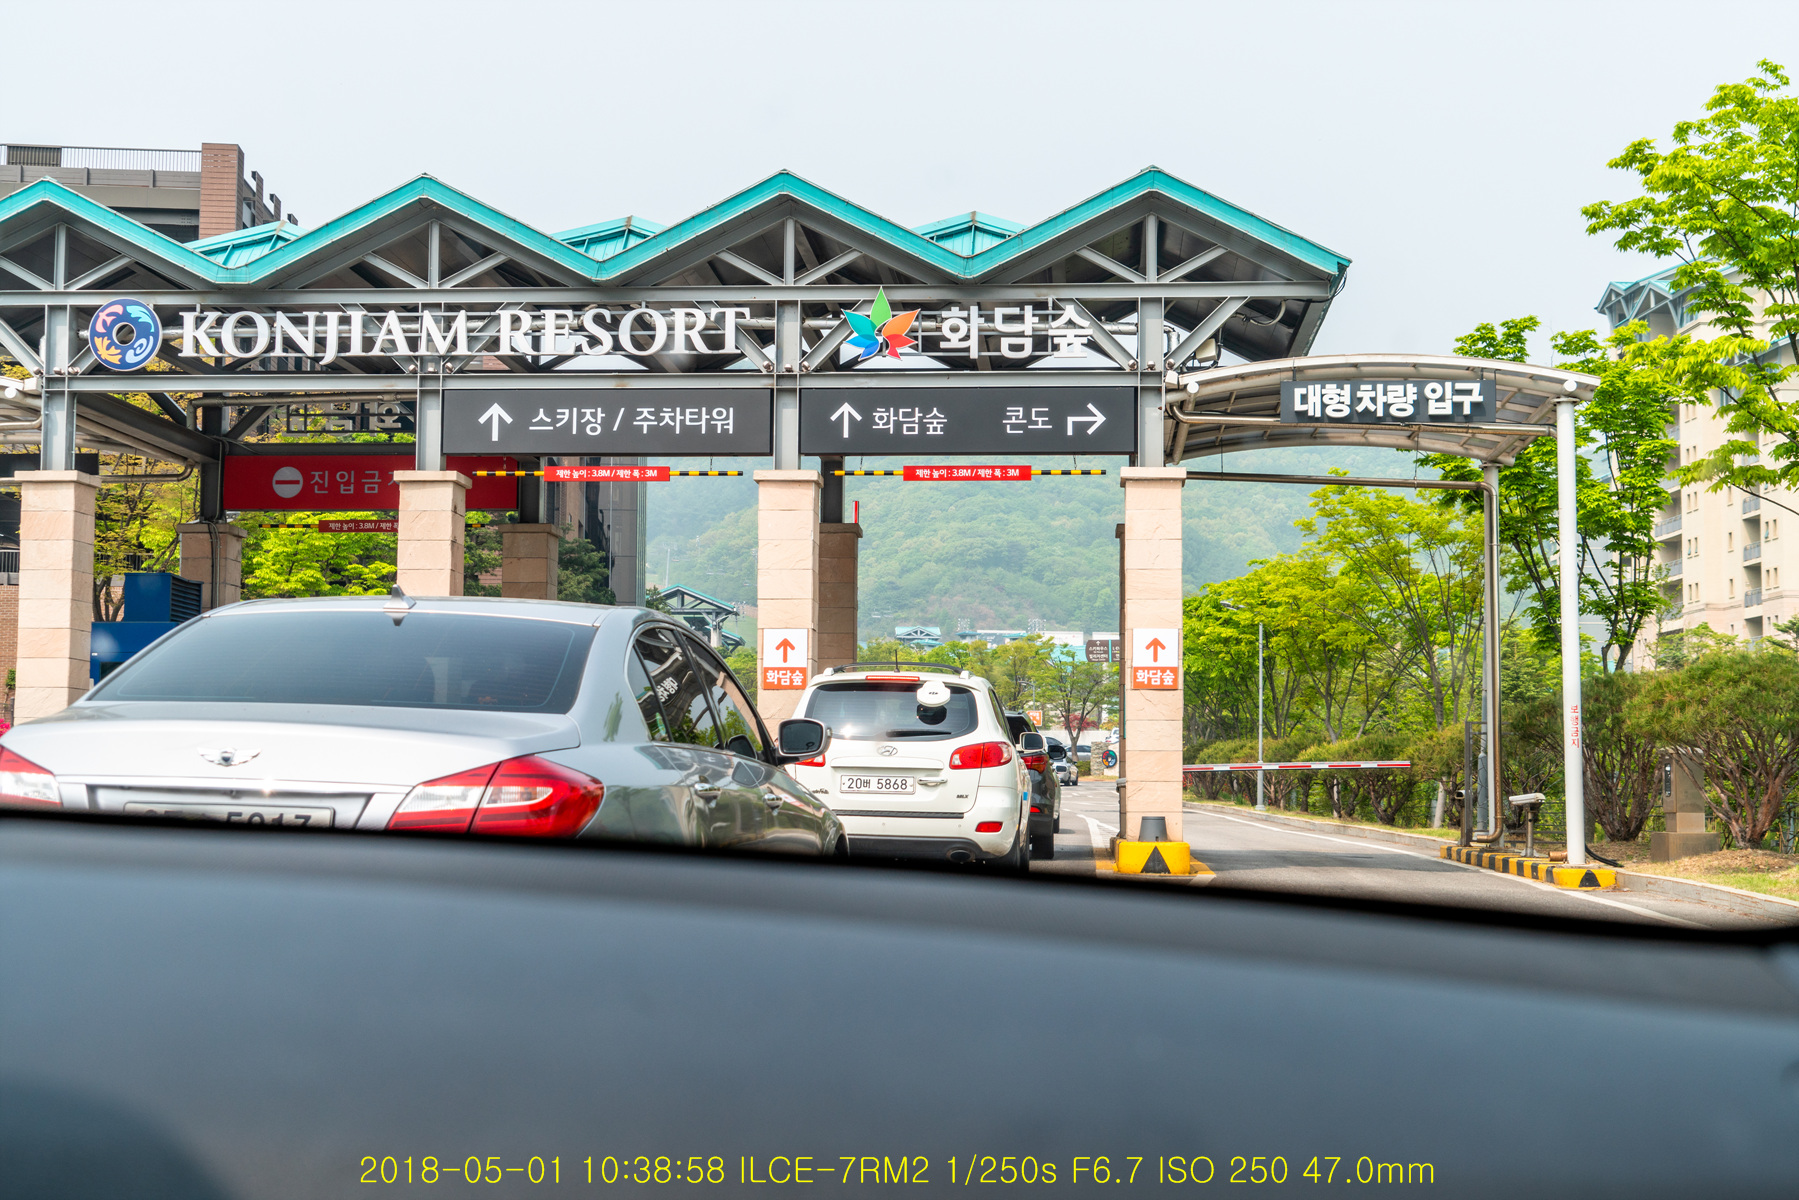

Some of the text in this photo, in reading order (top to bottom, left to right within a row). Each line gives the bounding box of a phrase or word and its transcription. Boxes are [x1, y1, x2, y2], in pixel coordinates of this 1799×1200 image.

[178, 307, 751, 365] KONJIAM RESORT
[939, 304, 1094, 359] 화담숲
[1293, 381, 1484, 418] 대형 차량 입구
[528, 407, 734, 436] 스키장 / 주차타워
[872, 407, 1053, 435] 화담숲 콘도
[556, 469, 571, 478] 제한
[572, 469, 587, 478] 높이
[592, 469, 610, 478] 3.8M
[616, 469, 631, 478] 제한
[632, 469, 640, 478] 폭
[645, 469, 658, 478] 3M
[915, 468, 930, 478] 제한
[932, 468, 947, 478] 높이
[952, 468, 971, 478] 3.8M
[977, 468, 992, 478] 제한
[993, 468, 1001, 478] 폭
[1007, 468, 1020, 478] 3M
[766, 669, 804, 686] 화담숲
[1135, 669, 1175, 686] 화담숲
[847, 777, 908, 790] 20버 5868
